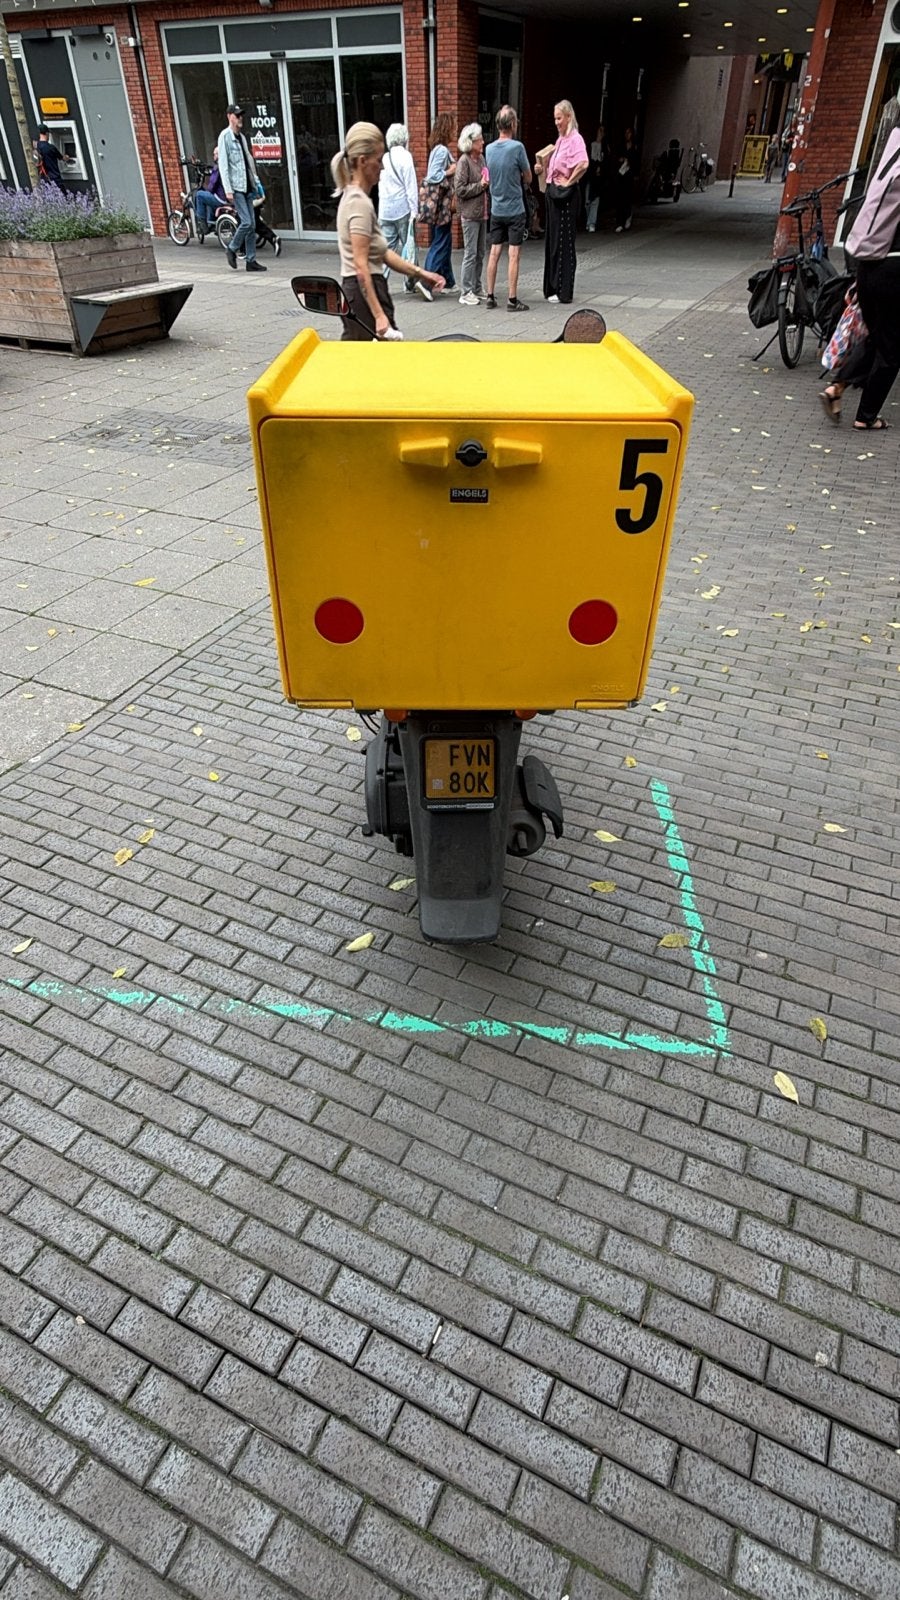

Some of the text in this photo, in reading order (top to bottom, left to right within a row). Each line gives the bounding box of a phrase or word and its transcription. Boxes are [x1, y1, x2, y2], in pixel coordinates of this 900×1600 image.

[256, 105, 267, 116] TE
[251, 117, 277, 128] KOOP
[452, 489, 487, 498] ENGELS
[615, 439, 669, 535] 5
[449, 744, 491, 766] FVN
[449, 771, 490, 794] 80K
